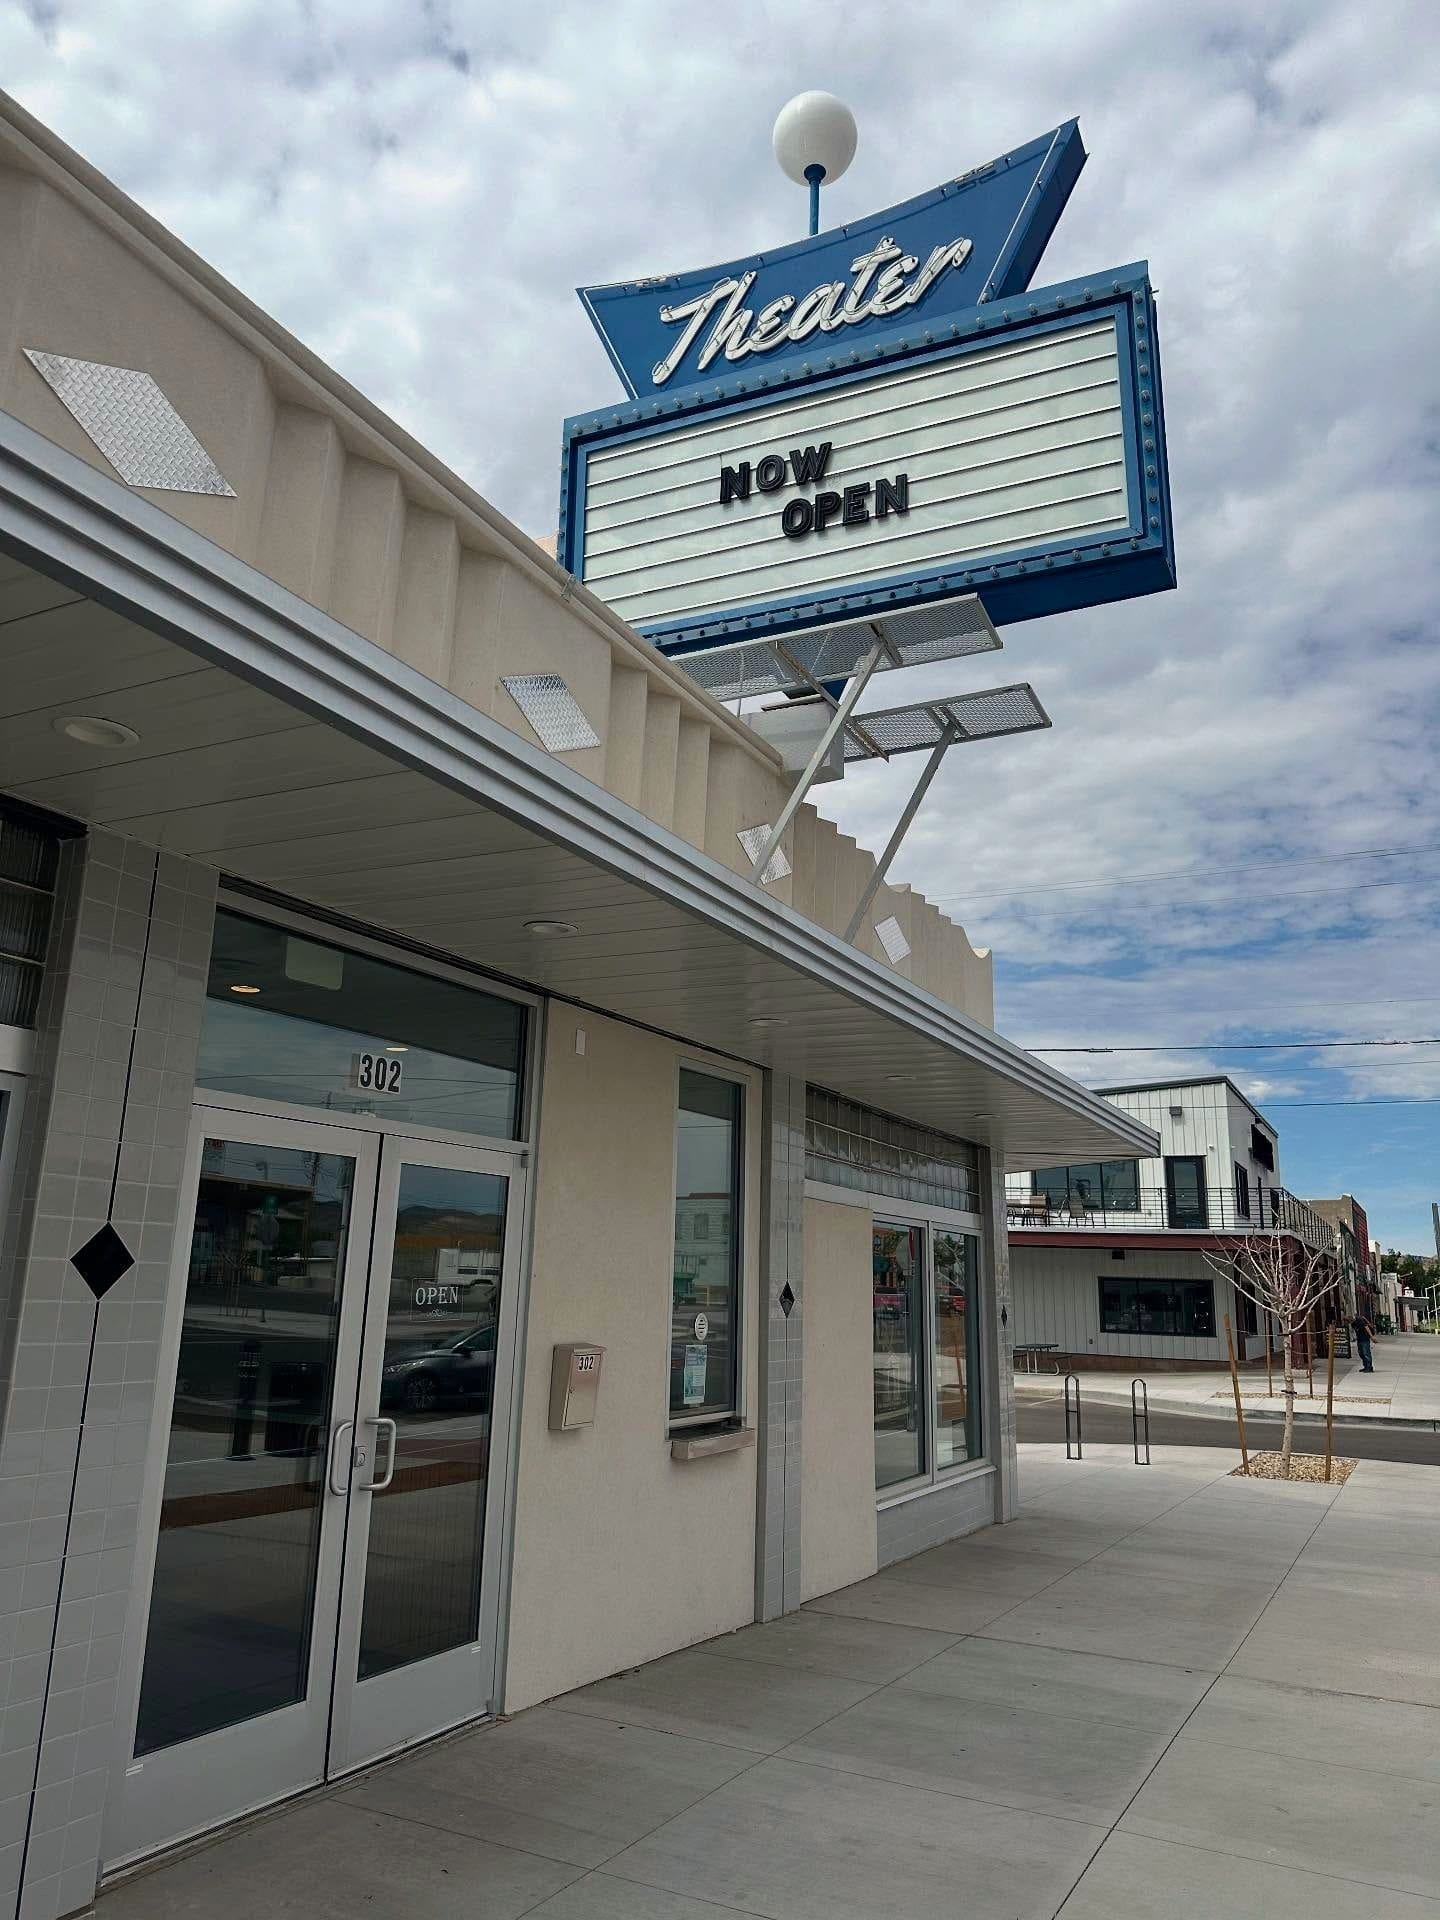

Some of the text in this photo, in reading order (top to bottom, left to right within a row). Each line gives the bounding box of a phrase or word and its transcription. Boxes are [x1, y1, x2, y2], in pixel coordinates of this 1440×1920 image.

[652, 236, 974, 384] Theater
[719, 441, 833, 505] NOW
[781, 473, 909, 538] OPEN
[360, 1054, 401, 1093] 302
[415, 1286, 459, 1306] OPEN
[578, 1356, 594, 1371] 302
